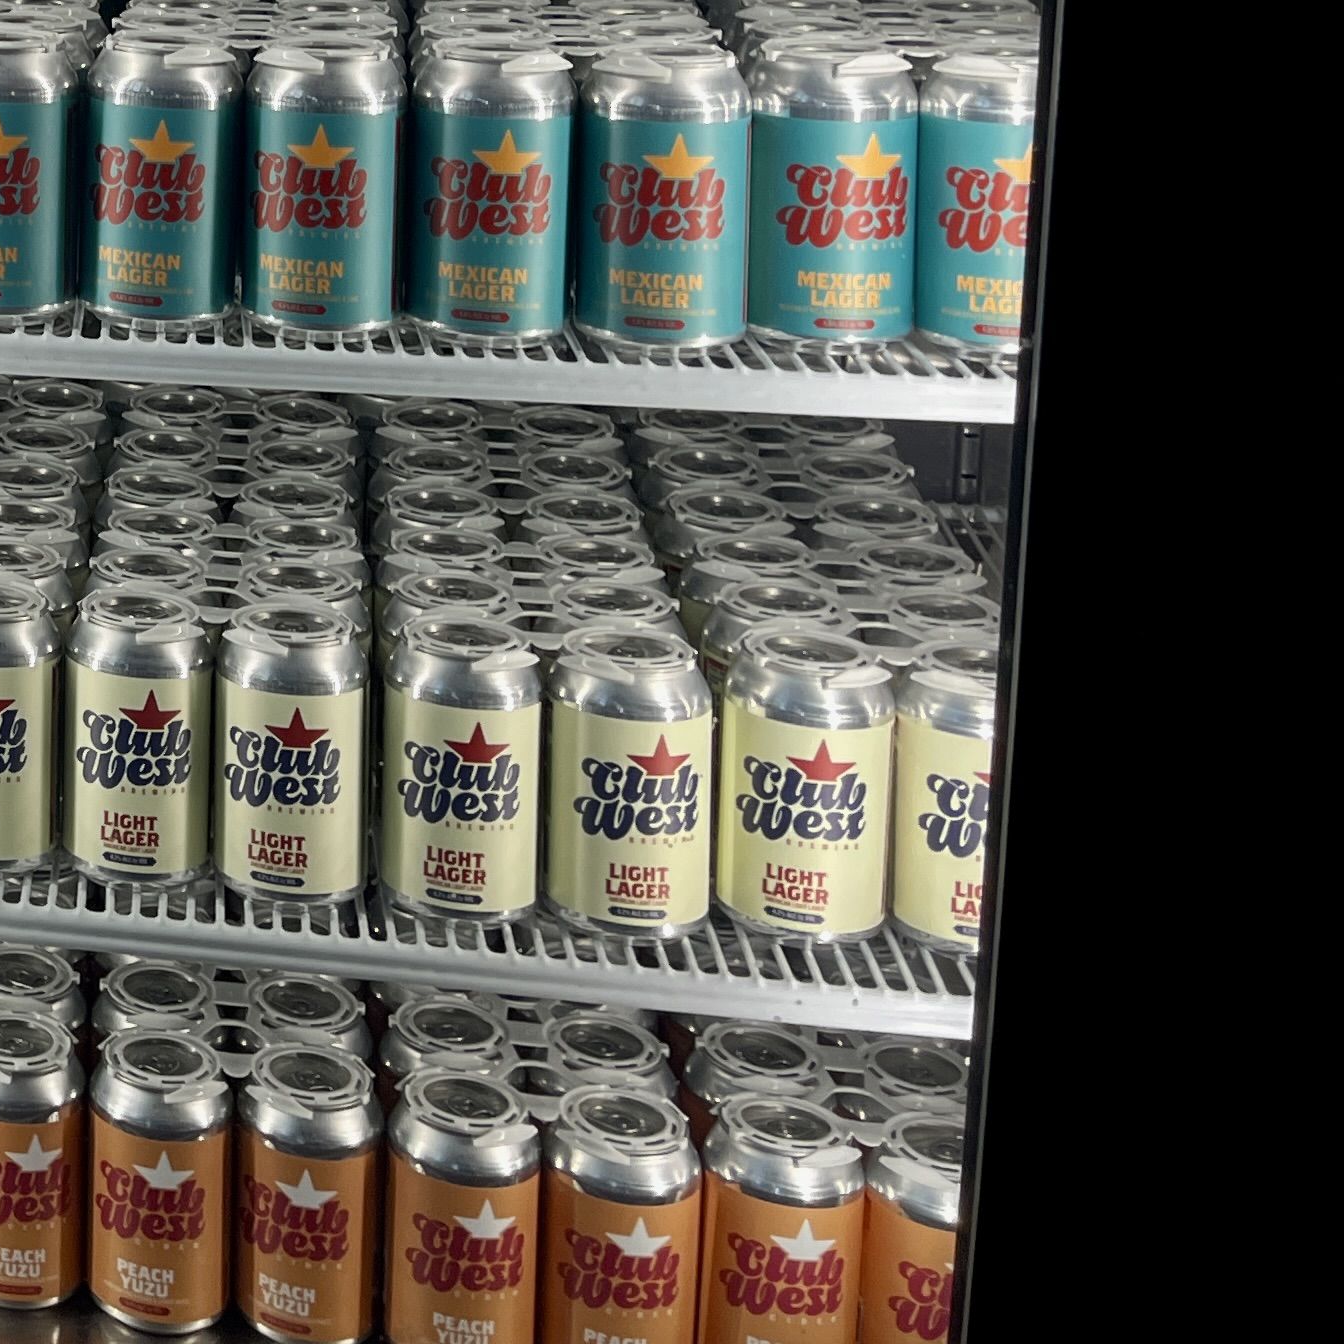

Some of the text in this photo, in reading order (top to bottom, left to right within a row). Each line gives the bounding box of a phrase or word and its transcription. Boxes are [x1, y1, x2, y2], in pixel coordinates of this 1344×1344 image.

[432, 157, 552, 203] Club
[600, 162, 725, 208] Club
[786, 161, 908, 208] Club
[425, 197, 551, 241] West
[594, 202, 725, 247] West
[776, 205, 907, 249] West
[438, 262, 528, 284] MEXICAN
[448, 280, 514, 302] LAGER
[610, 269, 703, 290] MEXICAN
[798, 270, 891, 290] MEXICAN
[620, 288, 690, 309] LAGER
[810, 288, 880, 309] LAGER
[83, 709, 191, 757] Club
[77, 745, 191, 790] West
[404, 741, 519, 793] Club
[581, 757, 699, 804] Club
[744, 755, 866, 812] Club
[397, 778, 519, 824] West
[574, 795, 699, 840] West
[736, 793, 866, 842] West
[101, 826, 160, 848] LAGER
[103, 810, 158, 830] LIGHT
[423, 861, 486, 886] LAGER
[426, 845, 484, 868] LIGHT
[609, 863, 669, 882] LIGHT
[605, 879, 671, 900] LAGER
[762, 878, 829, 905] LAGER
[766, 863, 827, 888] LIGHT
[100, 1160, 205, 1215] Club
[244, 1175, 349, 1234] Club
[96, 1192, 205, 1243] West
[241, 1207, 350, 1262] West
[117, 1258, 175, 1284] PEACH
[120, 1275, 170, 1298] YUZU
[258, 1272, 316, 1303] PEACH
[262, 1290, 310, 1317] YUZU
